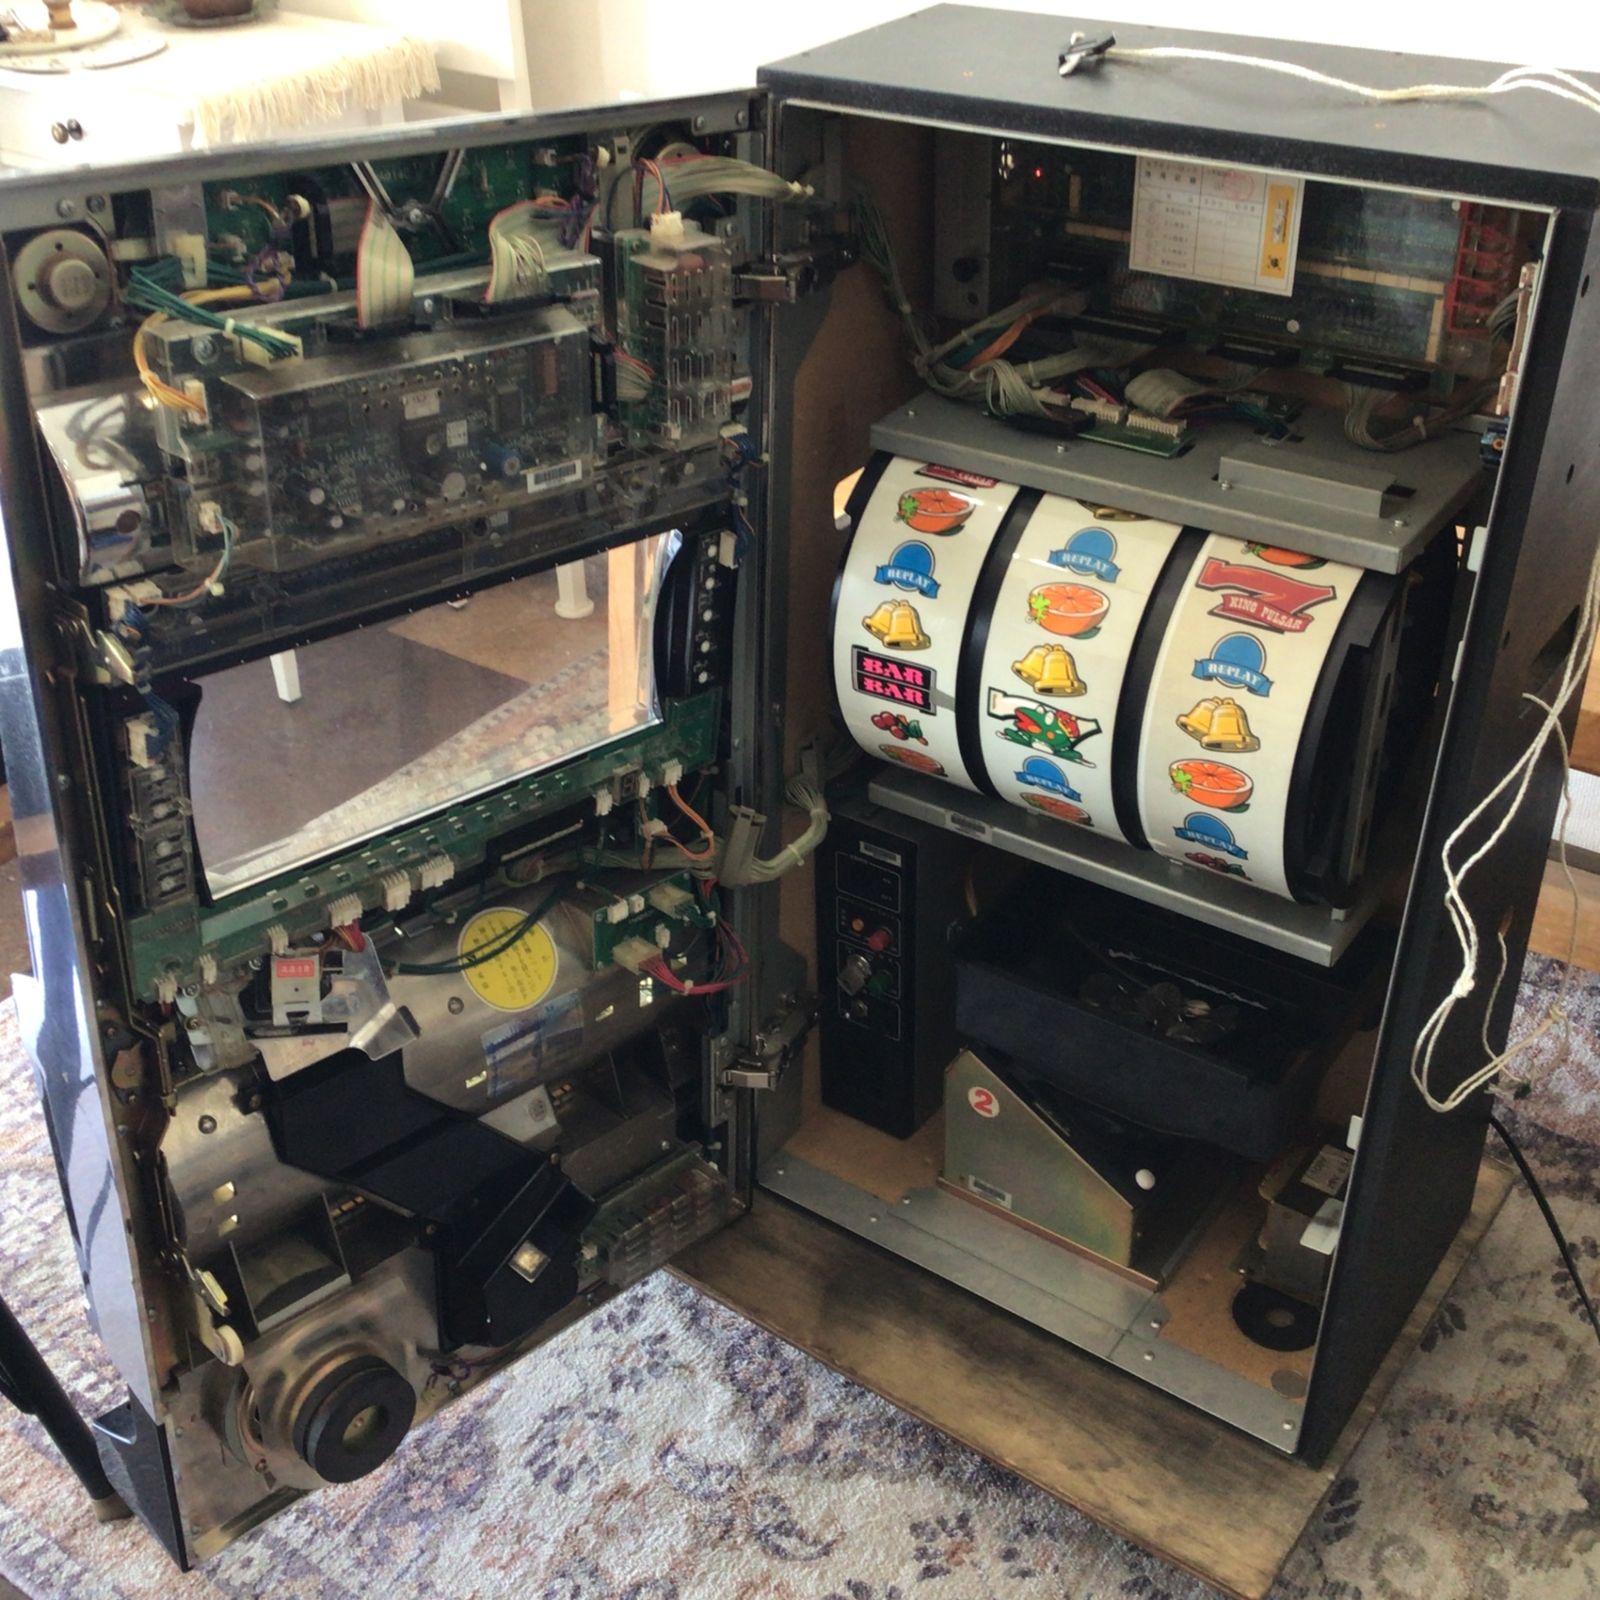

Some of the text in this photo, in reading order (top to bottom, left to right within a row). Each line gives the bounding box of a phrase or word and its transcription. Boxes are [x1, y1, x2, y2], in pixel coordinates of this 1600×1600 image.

[1062, 553, 1108, 572] REPLAY
[887, 568, 930, 588] REPLAY
[1229, 596, 1302, 630] KING PULSAR
[863, 657, 924, 686] BAR
[1208, 662, 1262, 686] REPLAY
[863, 677, 924, 705] BAR
[1025, 774, 1069, 794] REPLAY
[1187, 831, 1234, 852] REPLAY
[974, 1089, 993, 1116] 2
